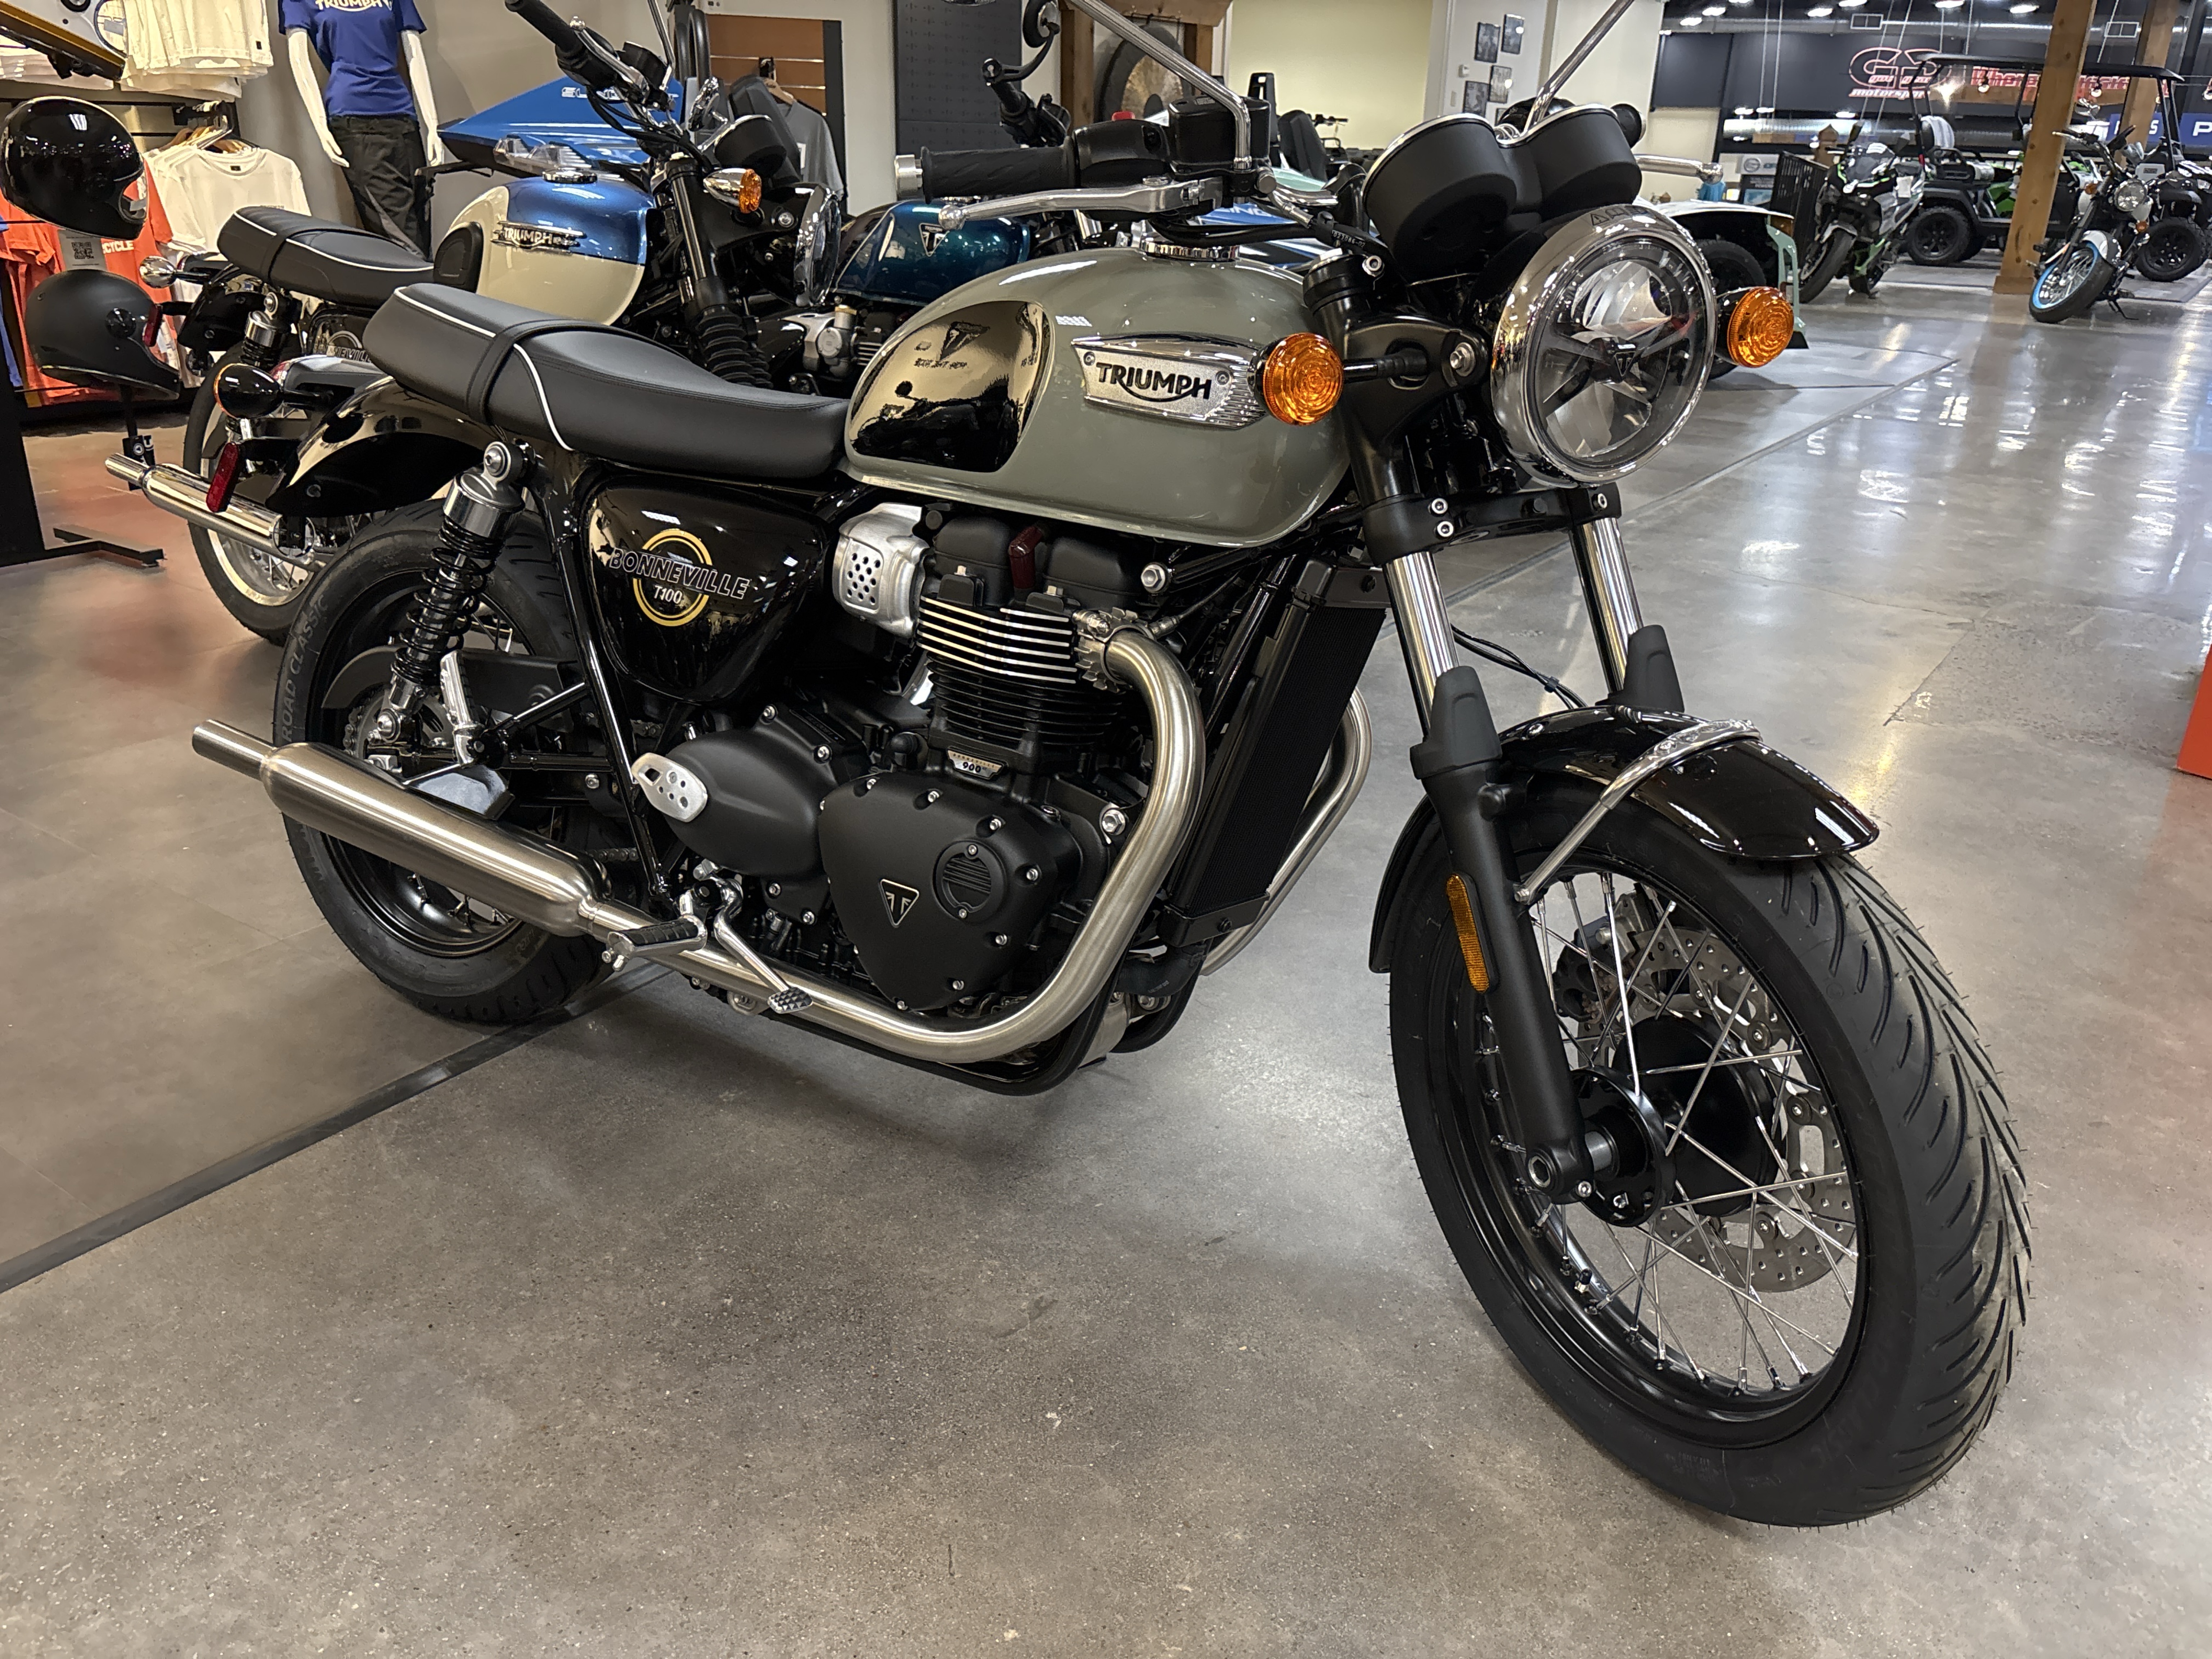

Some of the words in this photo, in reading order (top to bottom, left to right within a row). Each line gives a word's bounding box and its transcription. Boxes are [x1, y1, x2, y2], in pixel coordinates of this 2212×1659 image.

[504, 227, 552, 246] TRIUMPH
[1096, 363, 1212, 403] TRIUMPH
[609, 547, 750, 599] BONNEVILLE
[654, 585, 683, 604] T100
[282, 679, 296, 742] ROAD
[290, 594, 328, 675] CLASSIC
[962, 761, 981, 773] 900
